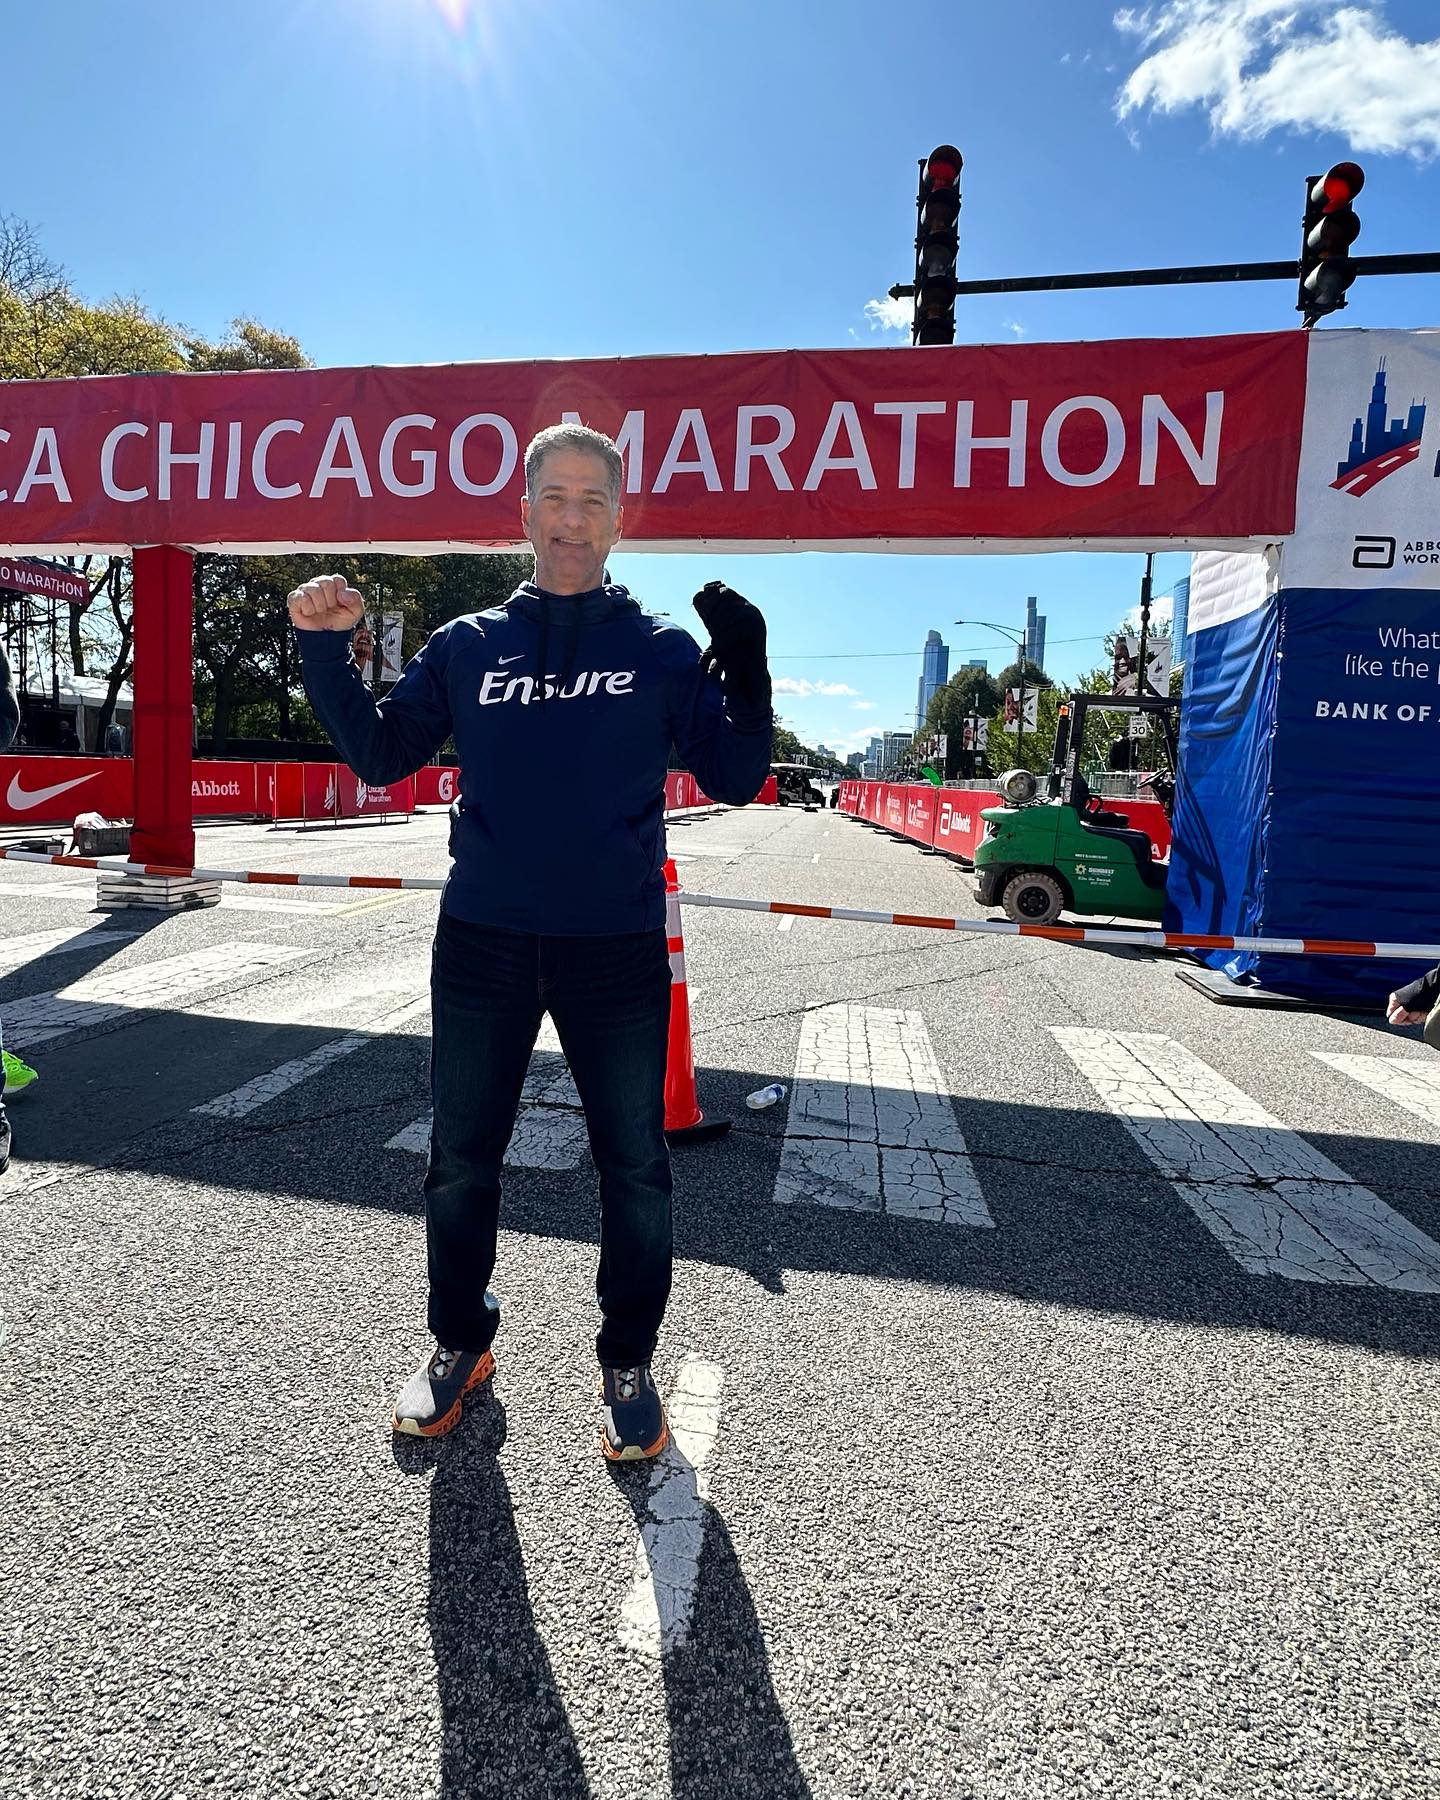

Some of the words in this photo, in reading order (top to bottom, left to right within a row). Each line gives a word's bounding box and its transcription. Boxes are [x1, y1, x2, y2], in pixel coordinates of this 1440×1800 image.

[0, 427, 73, 503] A
[100, 413, 518, 503] CHICAGO
[15, 570, 83, 598] MARATHON
[1378, 627, 1440, 650] What
[1345, 653, 1383, 677] like
[1392, 656, 1429, 679] the
[1315, 700, 1388, 721] BANK
[1397, 704, 1432, 722] OF
[1131, 726, 1145, 735] 30
[192, 780, 240, 797] Abbott
